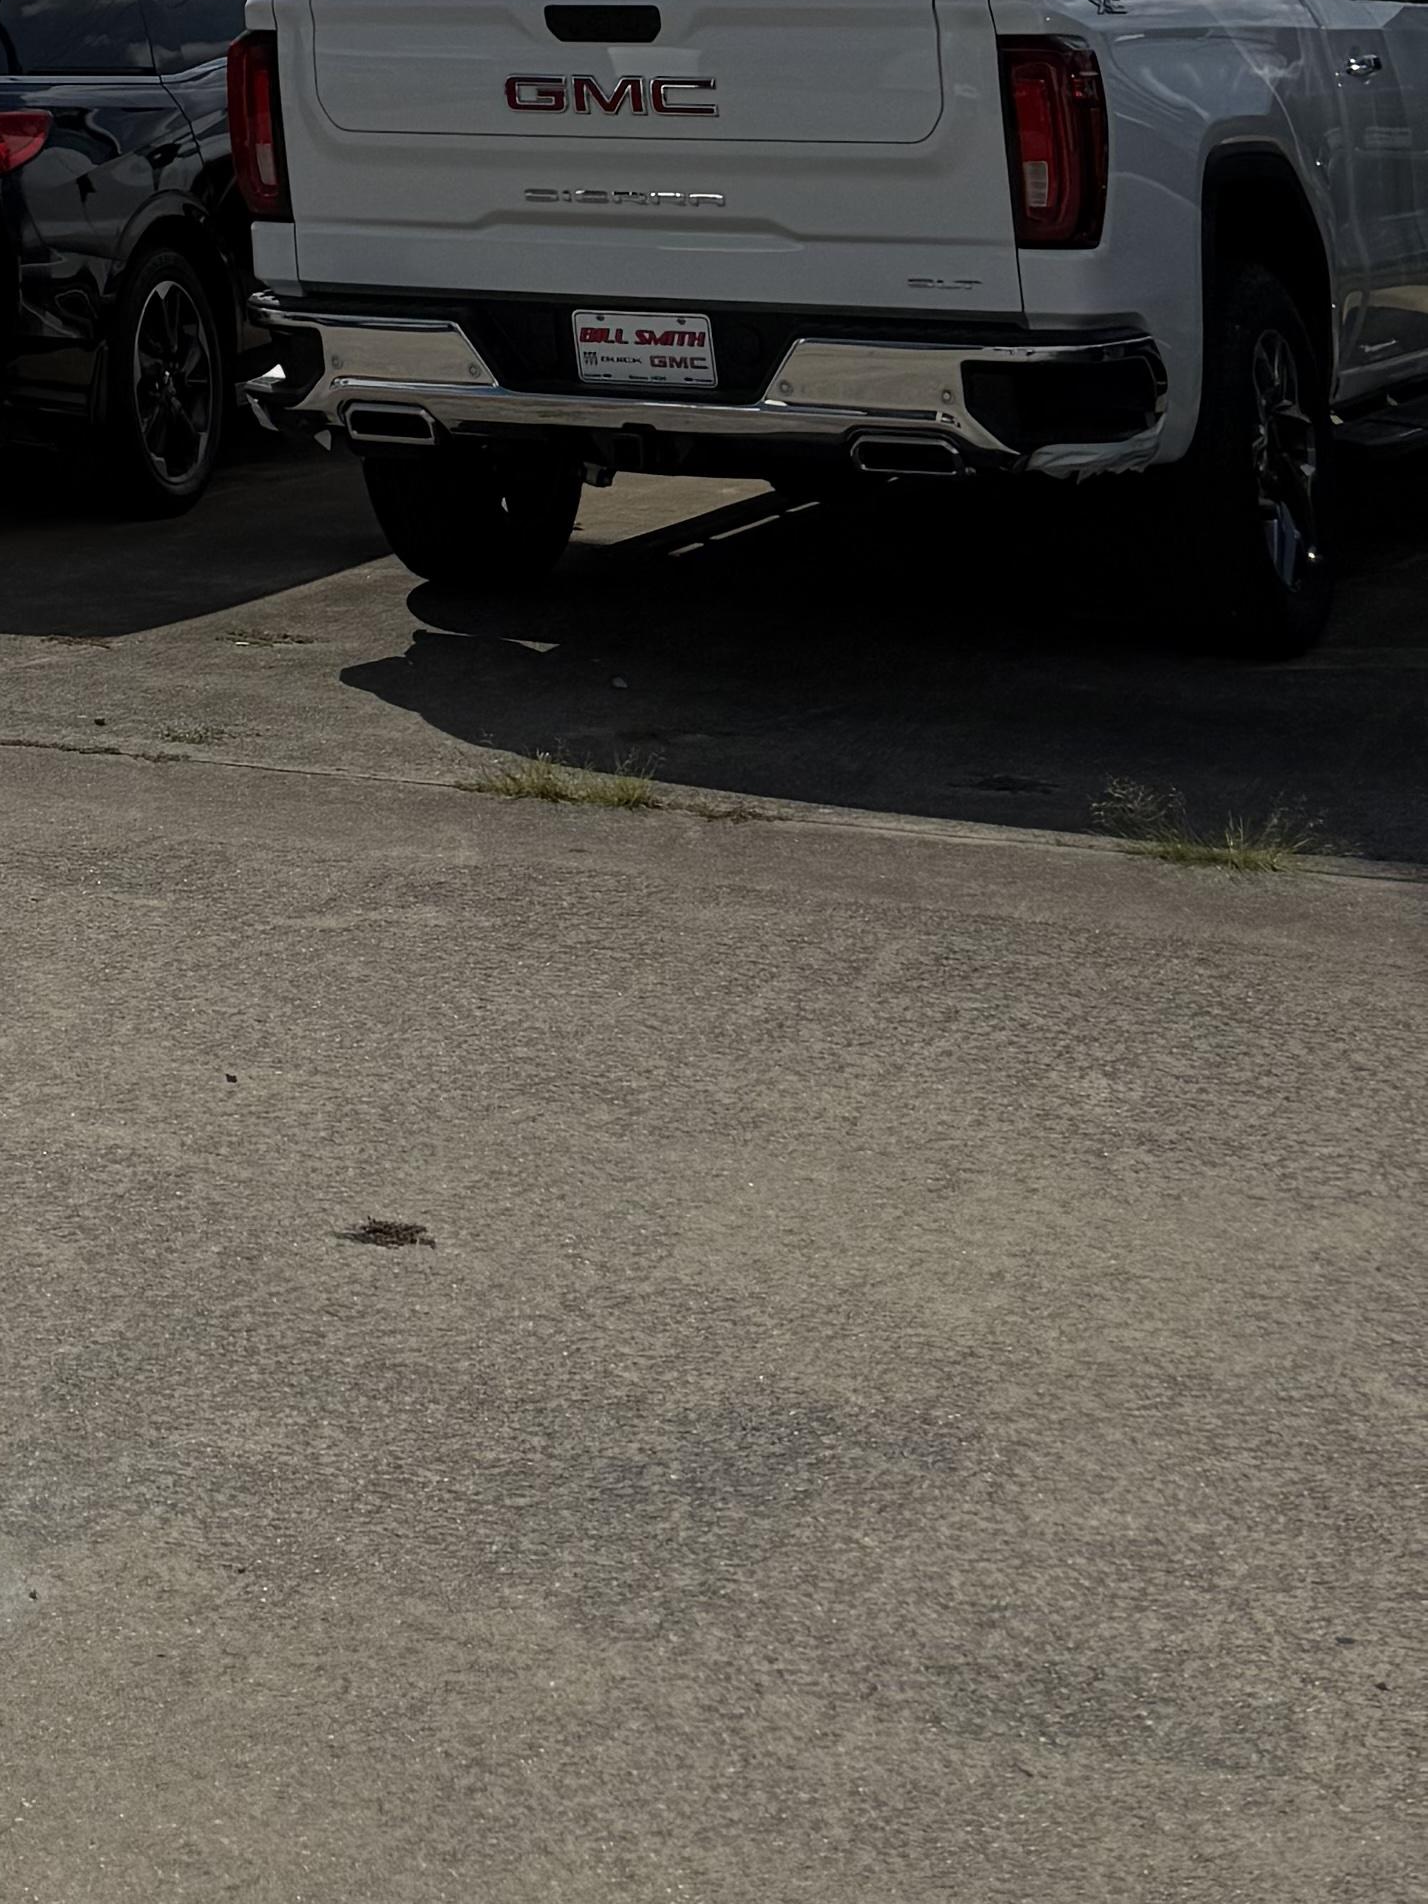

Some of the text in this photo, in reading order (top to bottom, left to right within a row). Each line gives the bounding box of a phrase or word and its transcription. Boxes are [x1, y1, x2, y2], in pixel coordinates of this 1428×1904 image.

[505, 73, 720, 117] GMC
[523, 189, 726, 207] SIERRA
[579, 327, 706, 347] BILL SMITH
[601, 355, 709, 369] BUICK GMC
